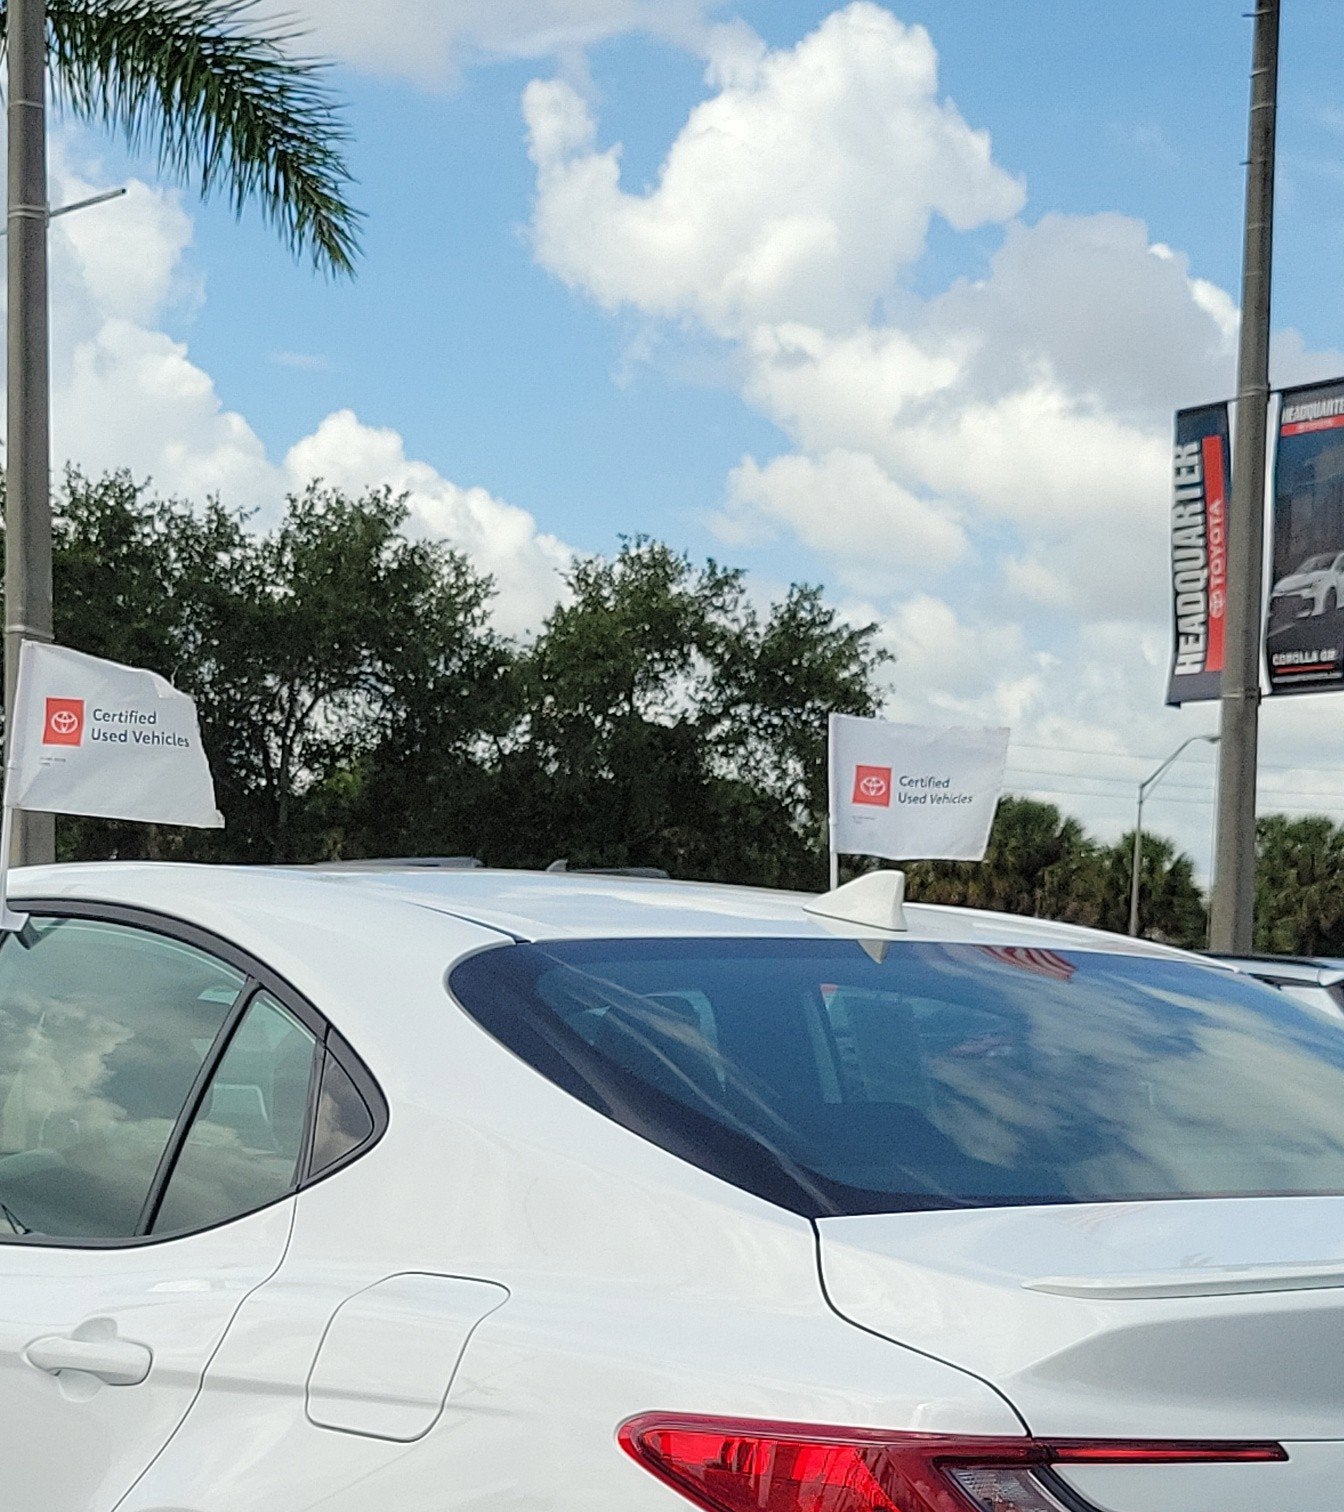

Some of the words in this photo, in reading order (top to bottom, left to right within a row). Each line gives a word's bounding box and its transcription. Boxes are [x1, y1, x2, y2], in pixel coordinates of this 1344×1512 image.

[1209, 500, 1226, 588] TOYOTA
[1172, 441, 1208, 675] HEADQUARTER
[92, 709, 156, 725] Certified
[91, 728, 127, 743] Used
[132, 731, 190, 748] Vehicles
[899, 775, 950, 789] Certified
[898, 792, 926, 805] Used
[930, 794, 973, 805] Vehicles
